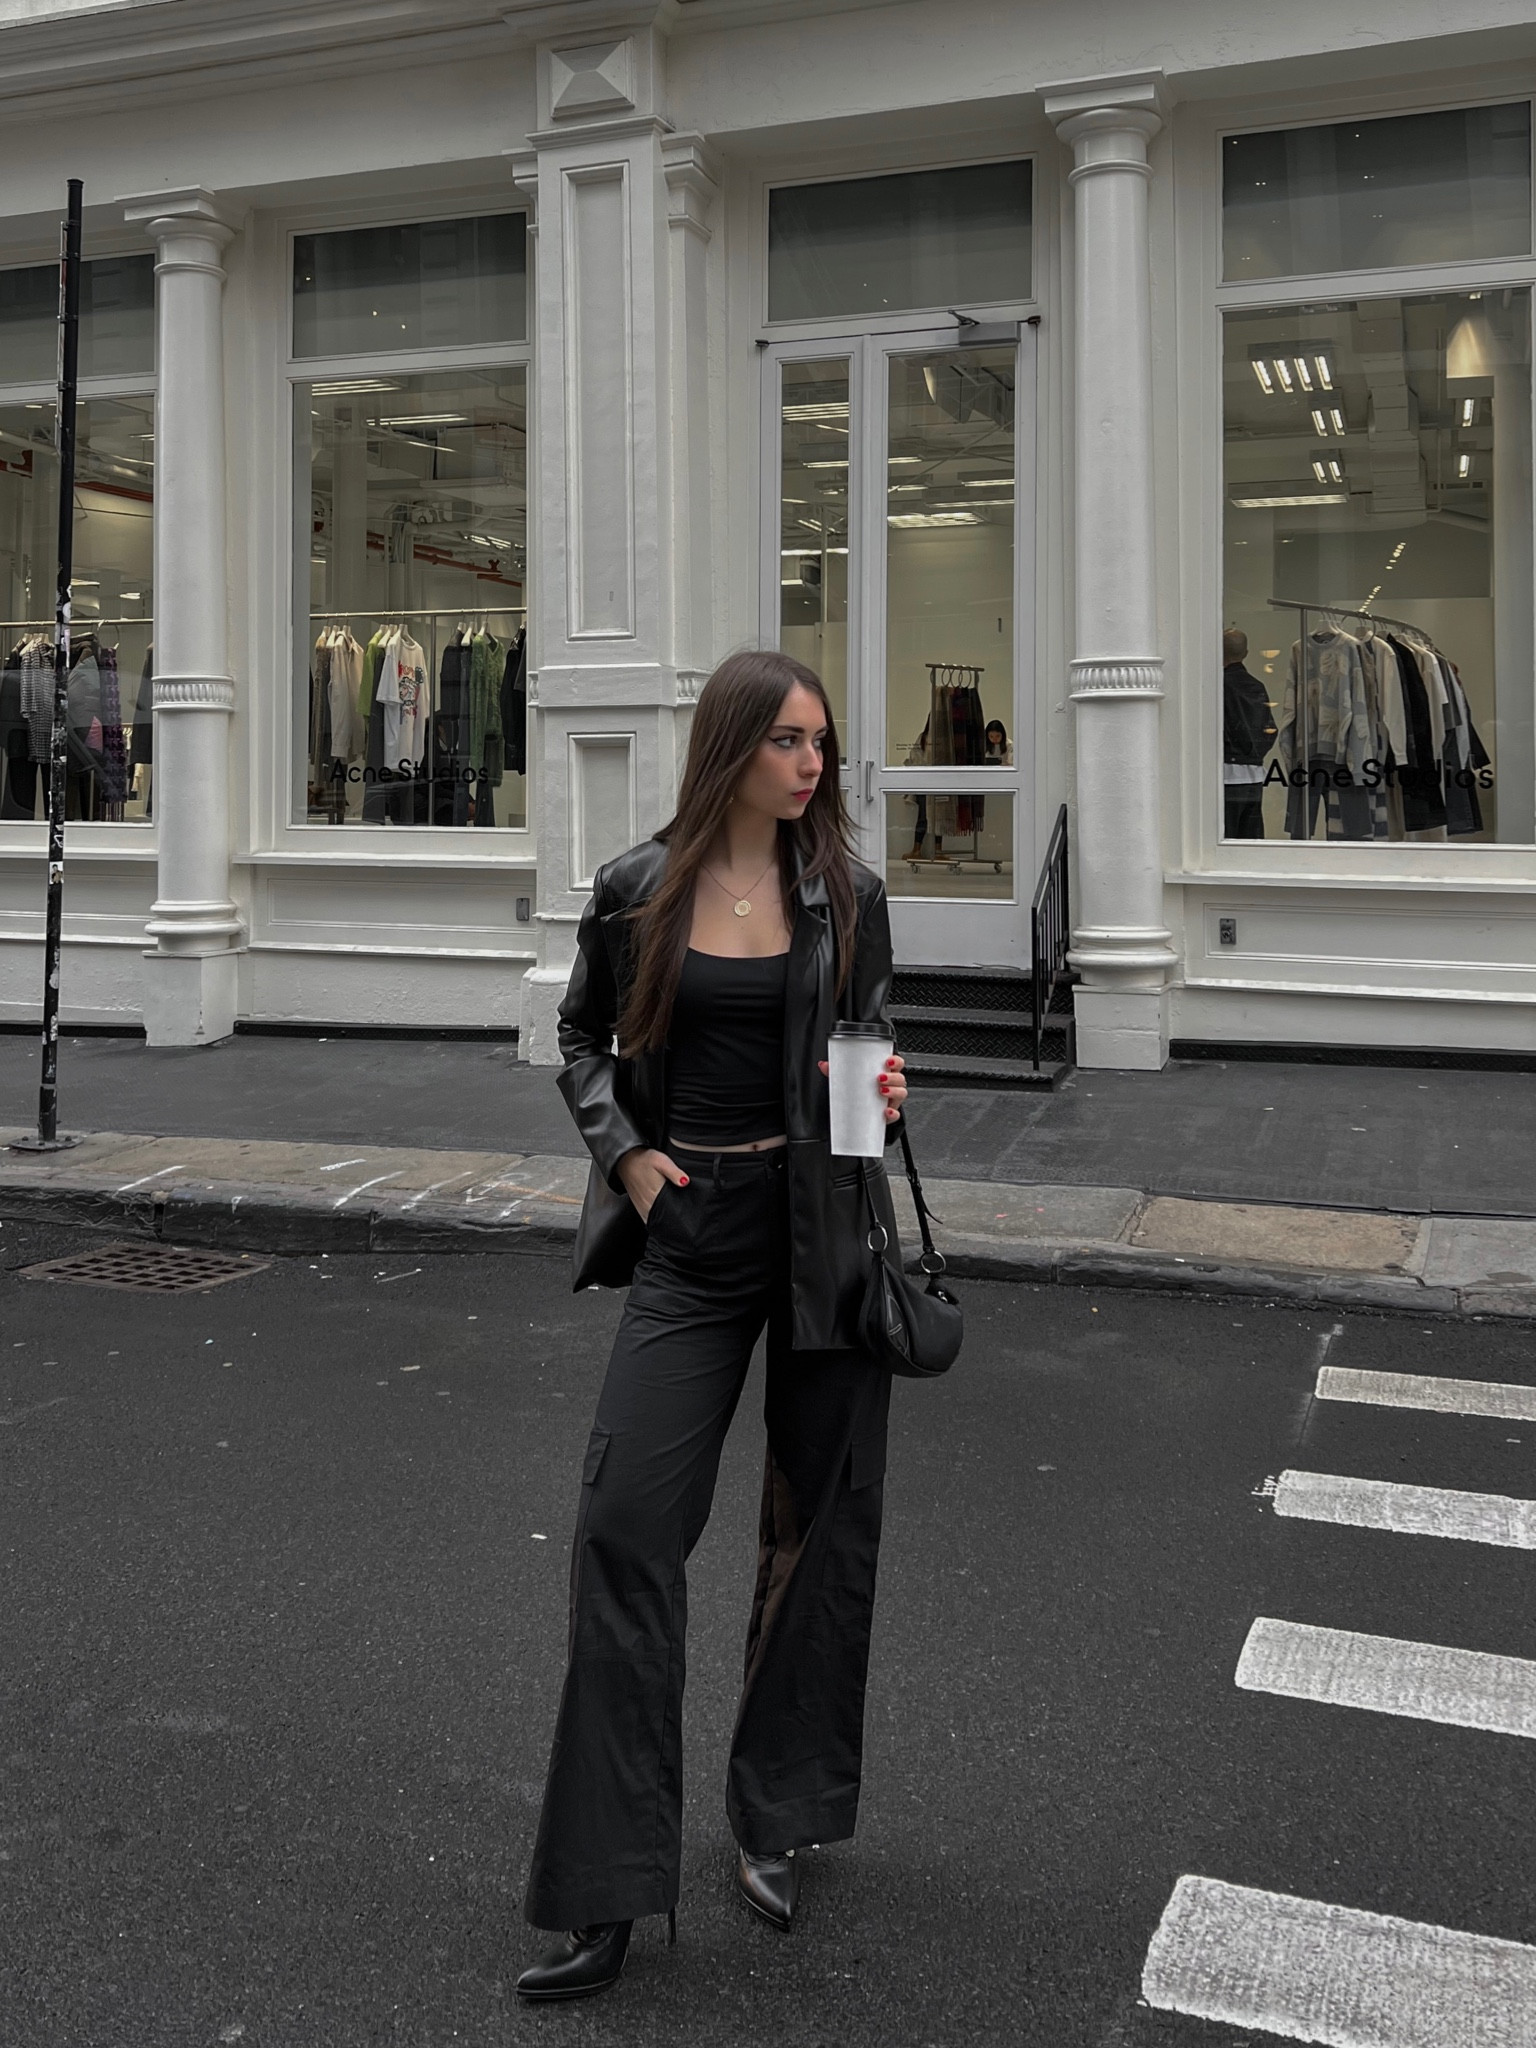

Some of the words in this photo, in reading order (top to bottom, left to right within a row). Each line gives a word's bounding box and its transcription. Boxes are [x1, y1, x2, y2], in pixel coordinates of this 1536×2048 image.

[330, 758, 393, 783] Acne
[398, 758, 488, 784] Studios
[1263, 758, 1353, 787] Acne
[1362, 758, 1493, 789] Studios
